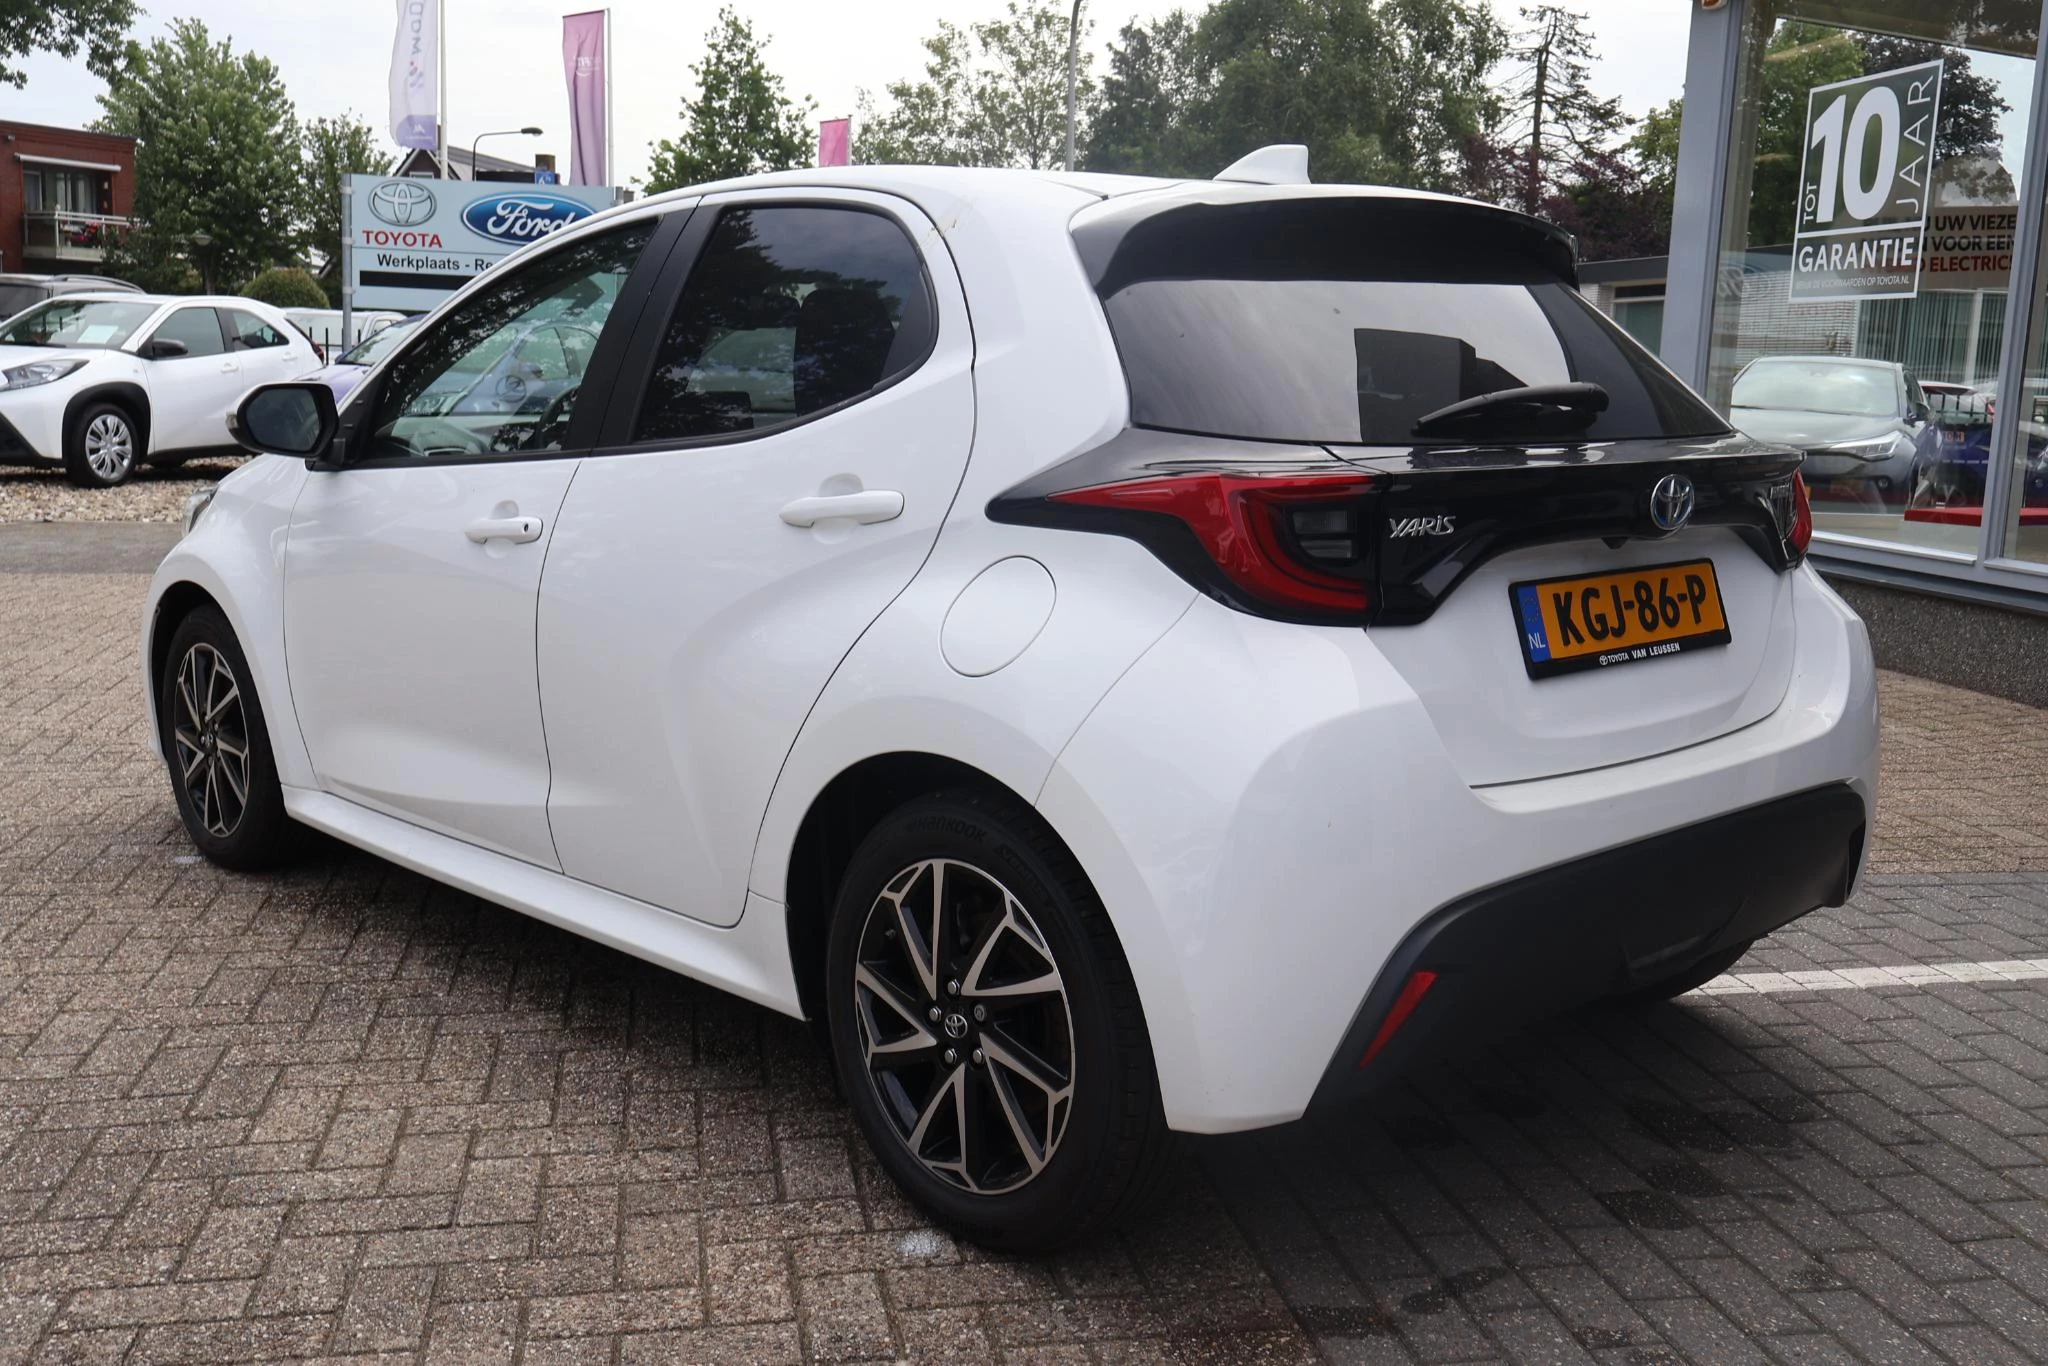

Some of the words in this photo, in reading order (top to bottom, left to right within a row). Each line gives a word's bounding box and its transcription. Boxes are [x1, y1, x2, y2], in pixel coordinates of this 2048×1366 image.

[1811, 86, 1900, 224] 10
[1896, 75, 1934, 214] JAAR
[1804, 182, 1817, 224] TOT
[487, 200, 576, 236] Ford
[1935, 215, 1966, 231] UW
[1969, 214, 2016, 230] VIEZE
[362, 230, 442, 248] TOYOTA
[1931, 235, 1982, 251] VOOR
[377, 254, 460, 272] Werkplaats
[1799, 237, 1914, 273] GARANTIE
[1389, 515, 1456, 538] YARIS
[1553, 574, 1706, 647] KGJ-86-P
[1529, 632, 1546, 650] NL
[1608, 652, 1630, 663] TOYOTA
[1631, 648, 1647, 660] VAN
[1649, 642, 1681, 656] LEUSSEN
